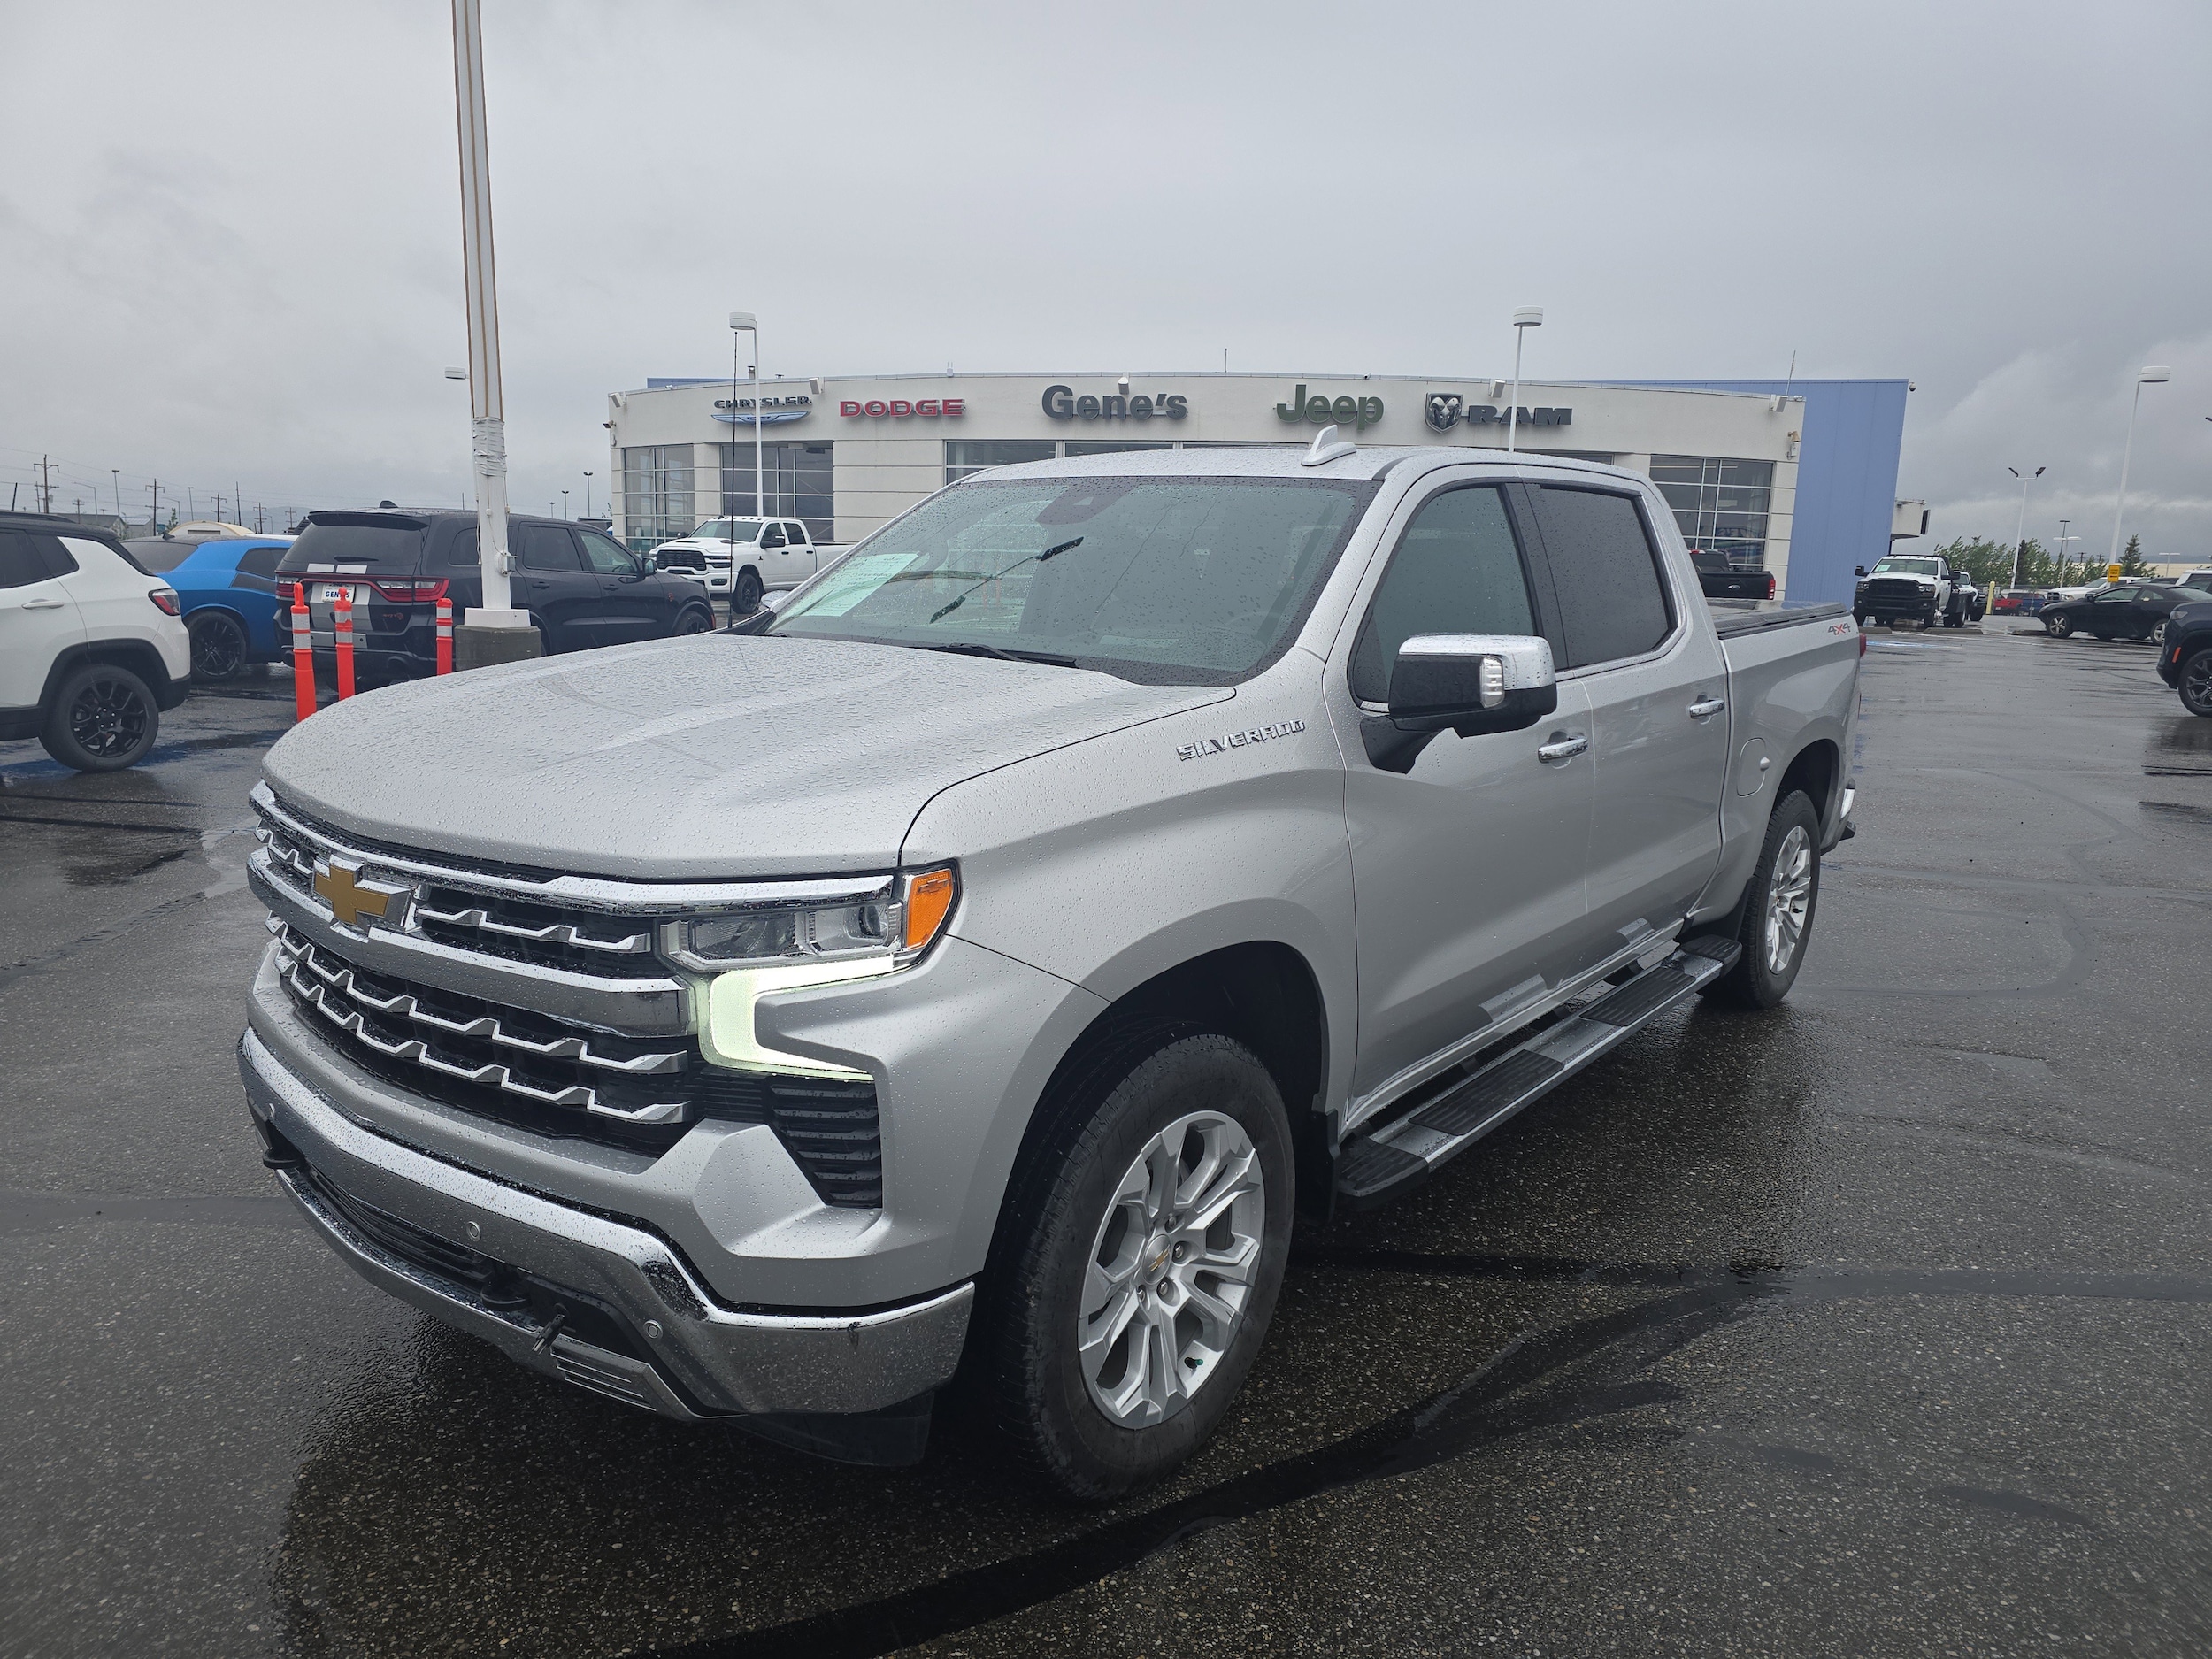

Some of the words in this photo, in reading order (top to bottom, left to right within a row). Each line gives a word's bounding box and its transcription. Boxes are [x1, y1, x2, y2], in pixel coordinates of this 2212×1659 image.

[840, 398, 965, 418] DODGE
[1041, 384, 1187, 420] Gene's
[1276, 383, 1385, 431] Jeep
[1468, 405, 1572, 425] RAM
[1176, 718, 1306, 762] SILVERADO
